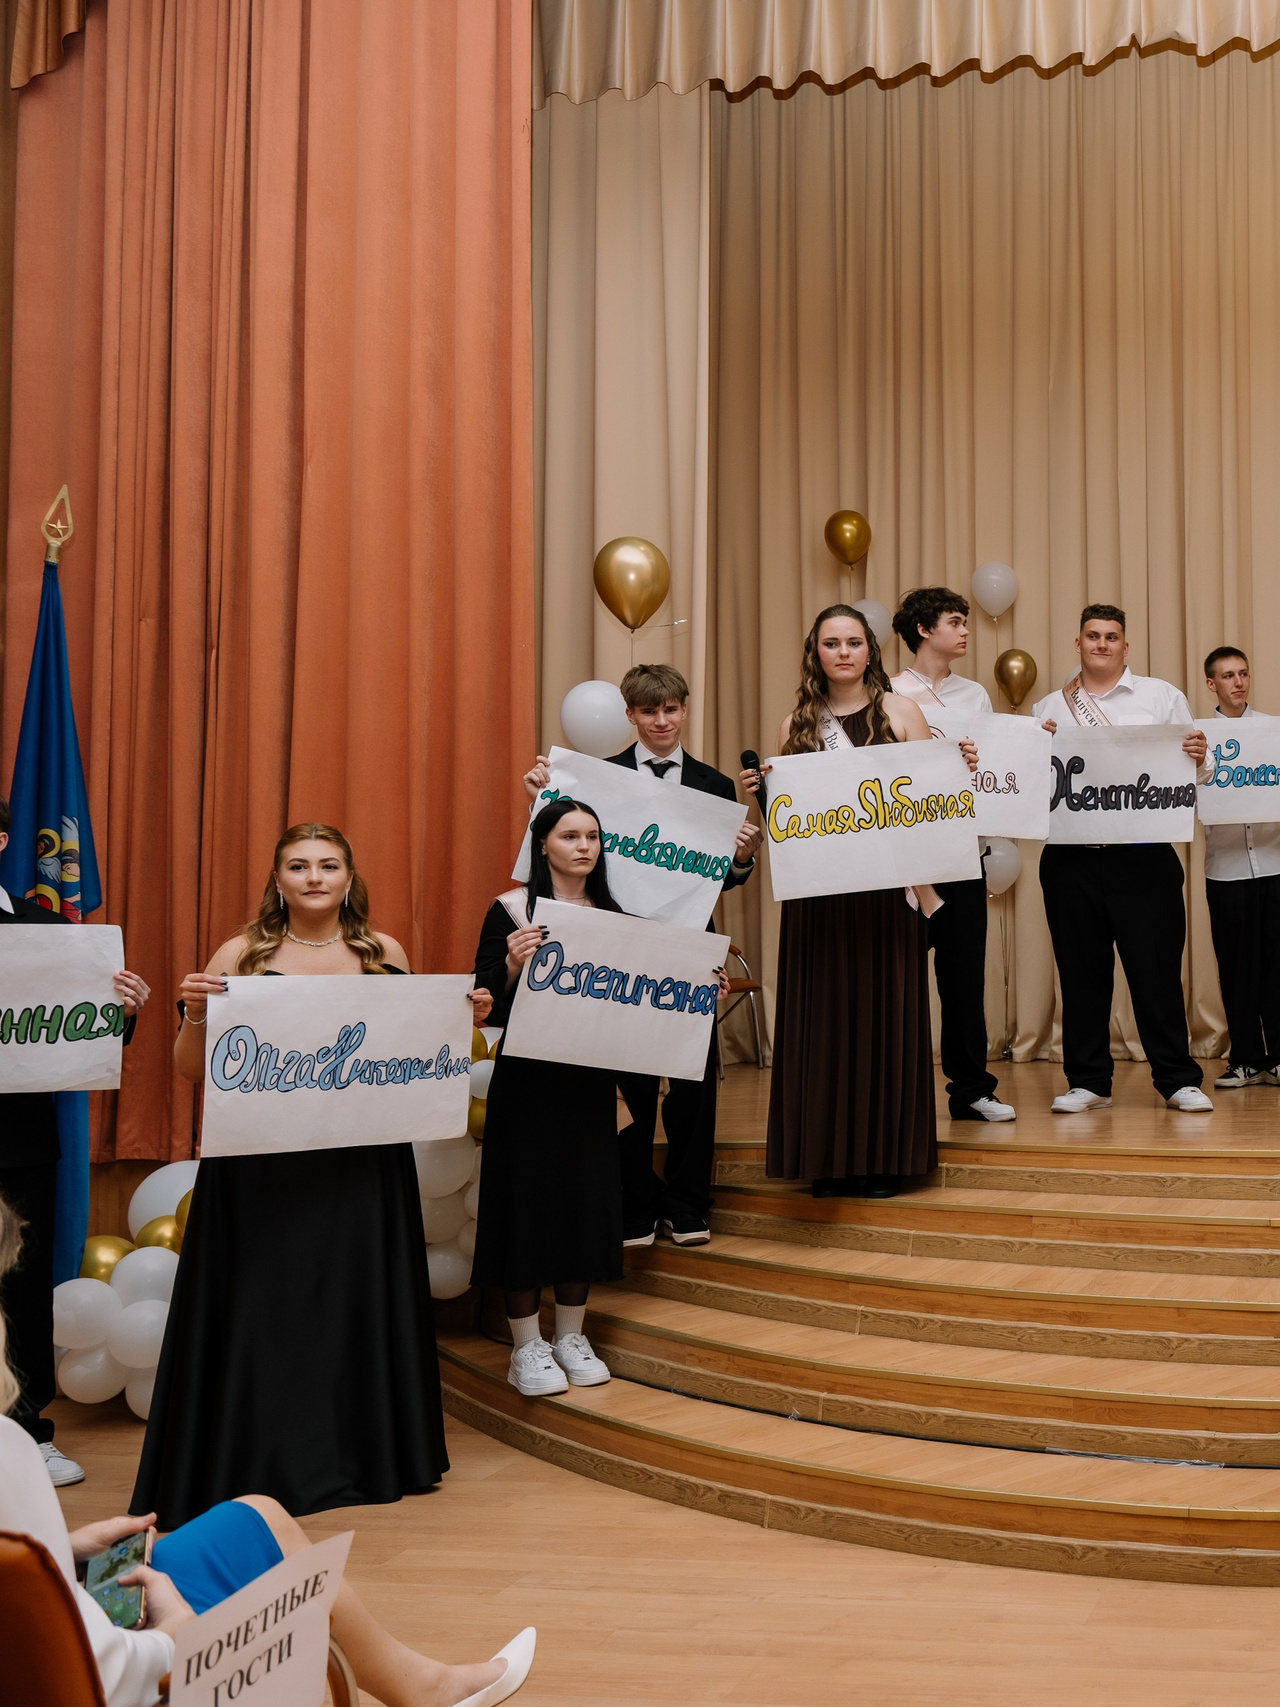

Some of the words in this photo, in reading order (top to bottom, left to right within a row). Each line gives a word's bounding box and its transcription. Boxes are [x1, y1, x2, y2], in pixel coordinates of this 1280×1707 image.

[768, 794, 860, 843] Самая
[0, 1001, 124, 1044] нная
[211, 1025, 318, 1092] Ольга
[317, 1021, 471, 1091] Николаевна
[183, 1570, 328, 1687] ПОЧЕТНЫЕ
[213, 1630, 294, 1707] ГОСТИ
